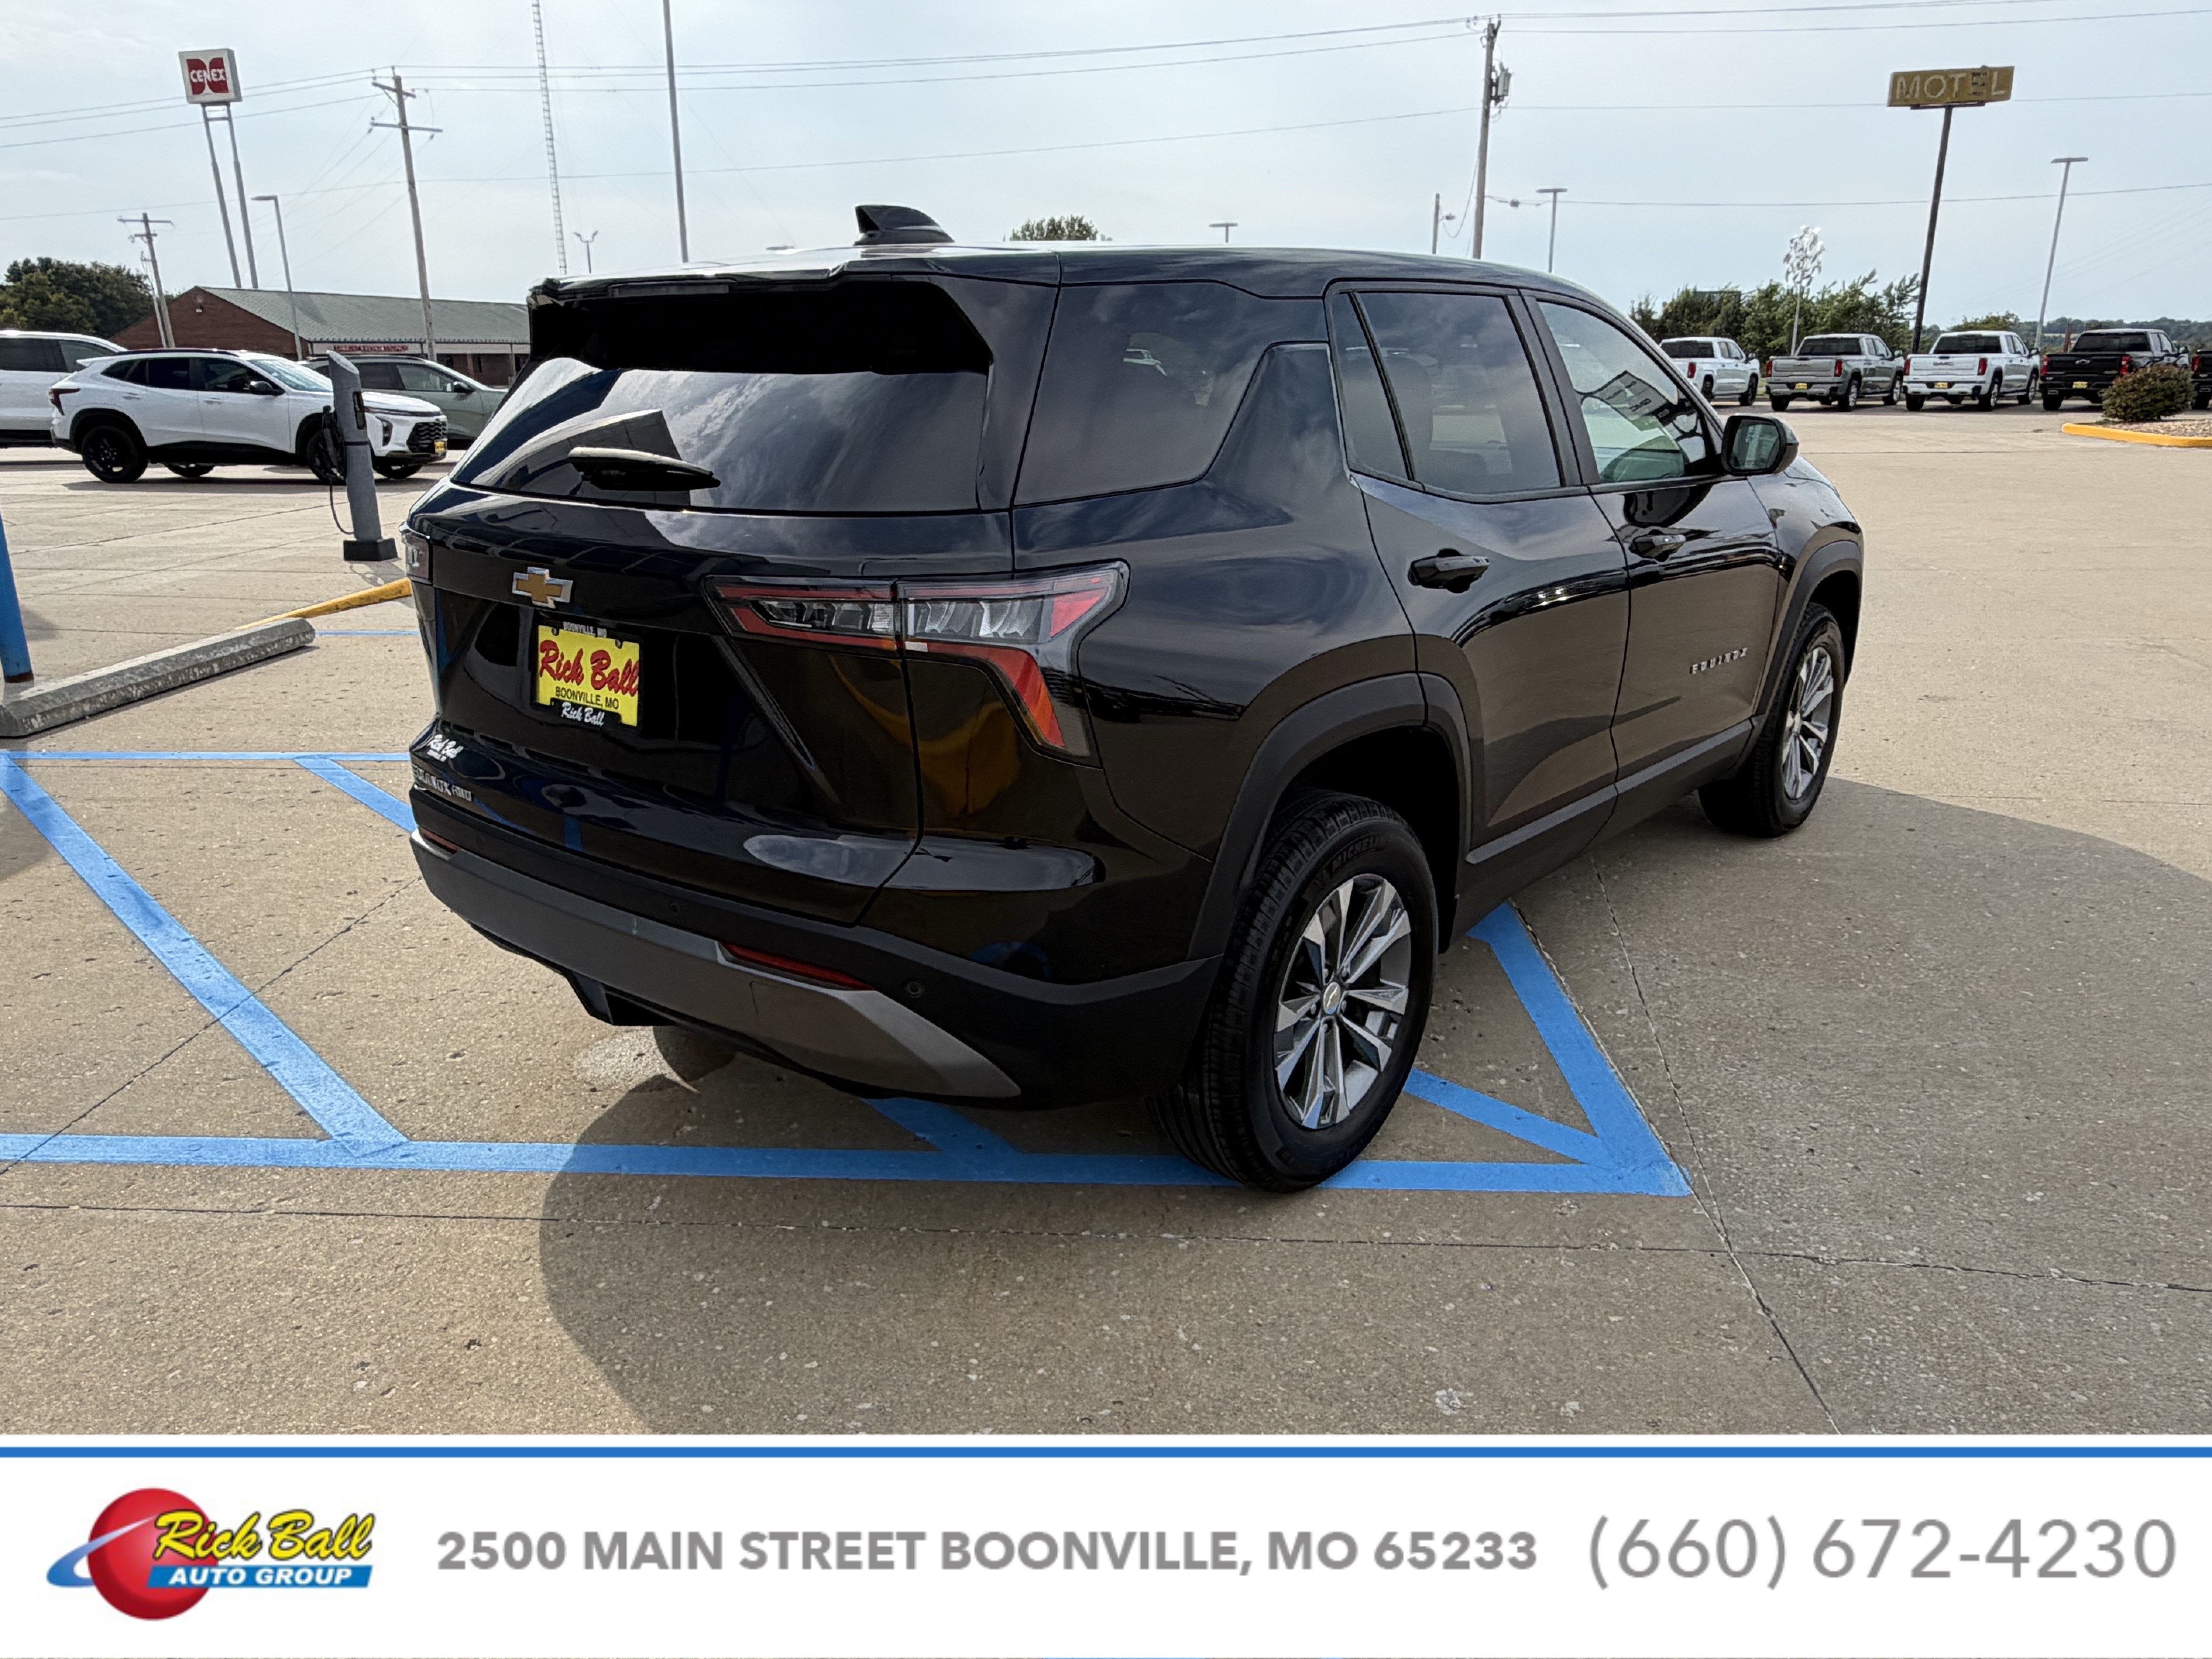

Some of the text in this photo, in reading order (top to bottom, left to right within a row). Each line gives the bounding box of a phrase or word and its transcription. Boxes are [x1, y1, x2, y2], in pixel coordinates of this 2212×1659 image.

[190, 68, 226, 83] CENEX
[1896, 71, 2008, 100] MOTEL
[539, 640, 639, 697] Rick Ball
[1692, 647, 1748, 675] EQUINOX
[555, 686, 620, 710] BOONVILLE, MO
[562, 701, 605, 727] Rick Ball
